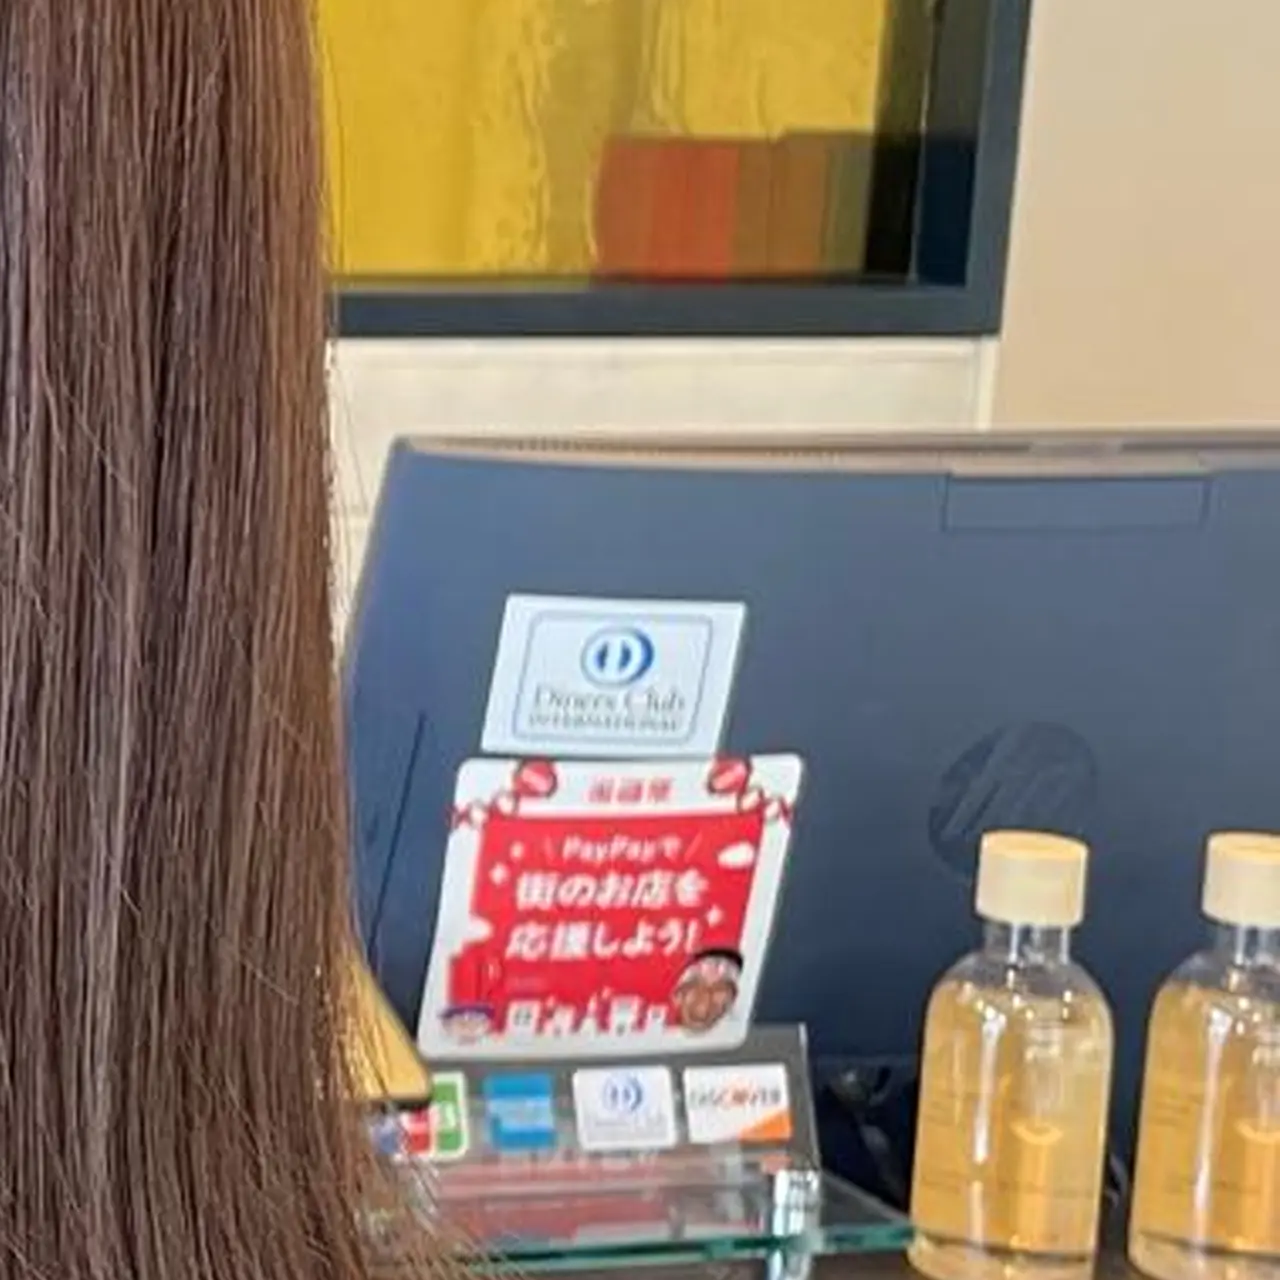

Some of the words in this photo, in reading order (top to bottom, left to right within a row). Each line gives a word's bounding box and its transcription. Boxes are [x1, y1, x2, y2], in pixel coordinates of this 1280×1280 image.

[516, 870, 708, 911] 街のお店を
